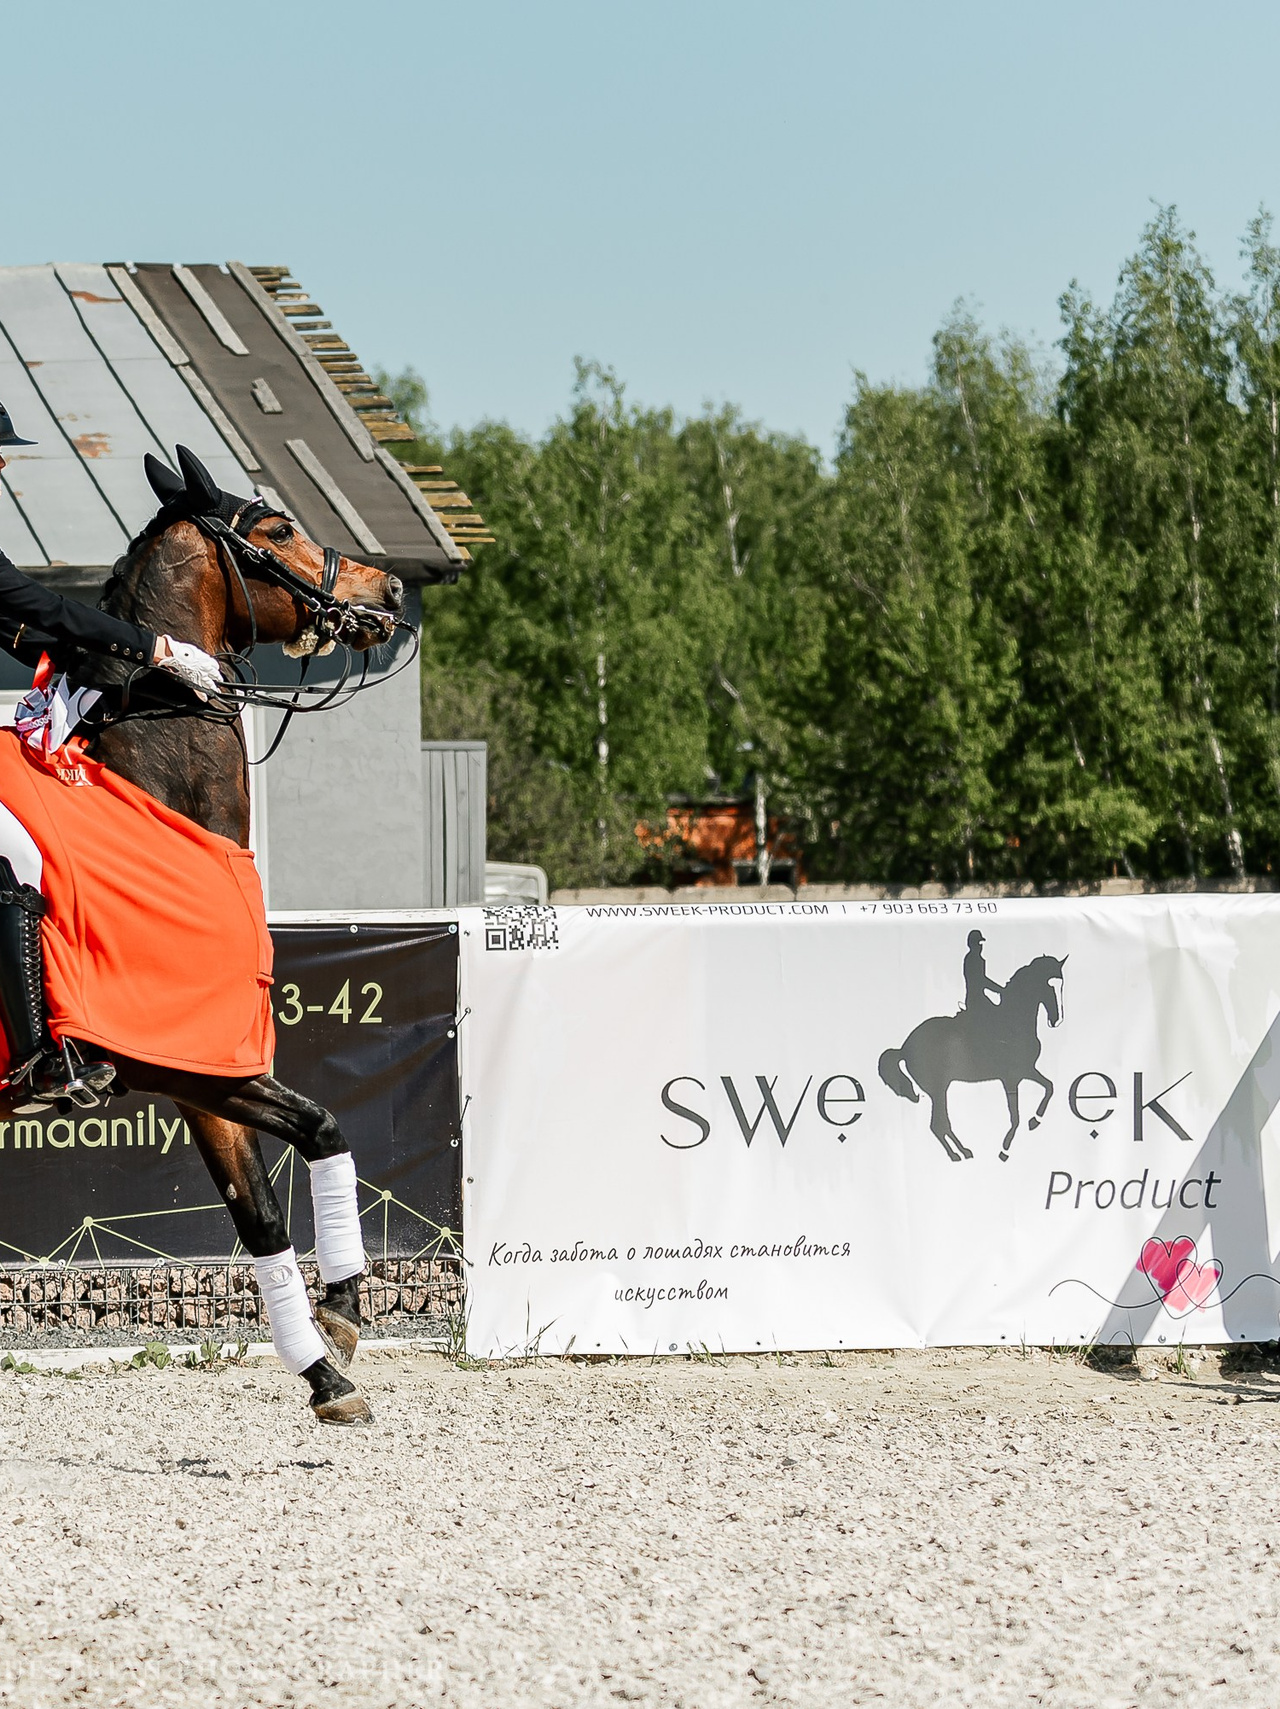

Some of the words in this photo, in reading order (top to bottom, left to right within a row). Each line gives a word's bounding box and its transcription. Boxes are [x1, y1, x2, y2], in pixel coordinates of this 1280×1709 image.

[585, 904, 829, 918] WWW.SWEEK-PRODUCT.COM
[860, 904, 877, 914] +7
[882, 903, 914, 914] 903
[918, 902, 949, 914] 663
[951, 902, 973, 914] 73
[977, 902, 998, 913] 60
[270, 978, 383, 1026] 3-42
[1044, 1168, 1222, 1211] Product
[488, 1241, 543, 1267] Когда
[549, 1240, 619, 1263] забота
[626, 1248, 636, 1261] о
[642, 1238, 724, 1261] лошадях
[729, 1235, 852, 1260] становится
[613, 1279, 729, 1310] искусством
